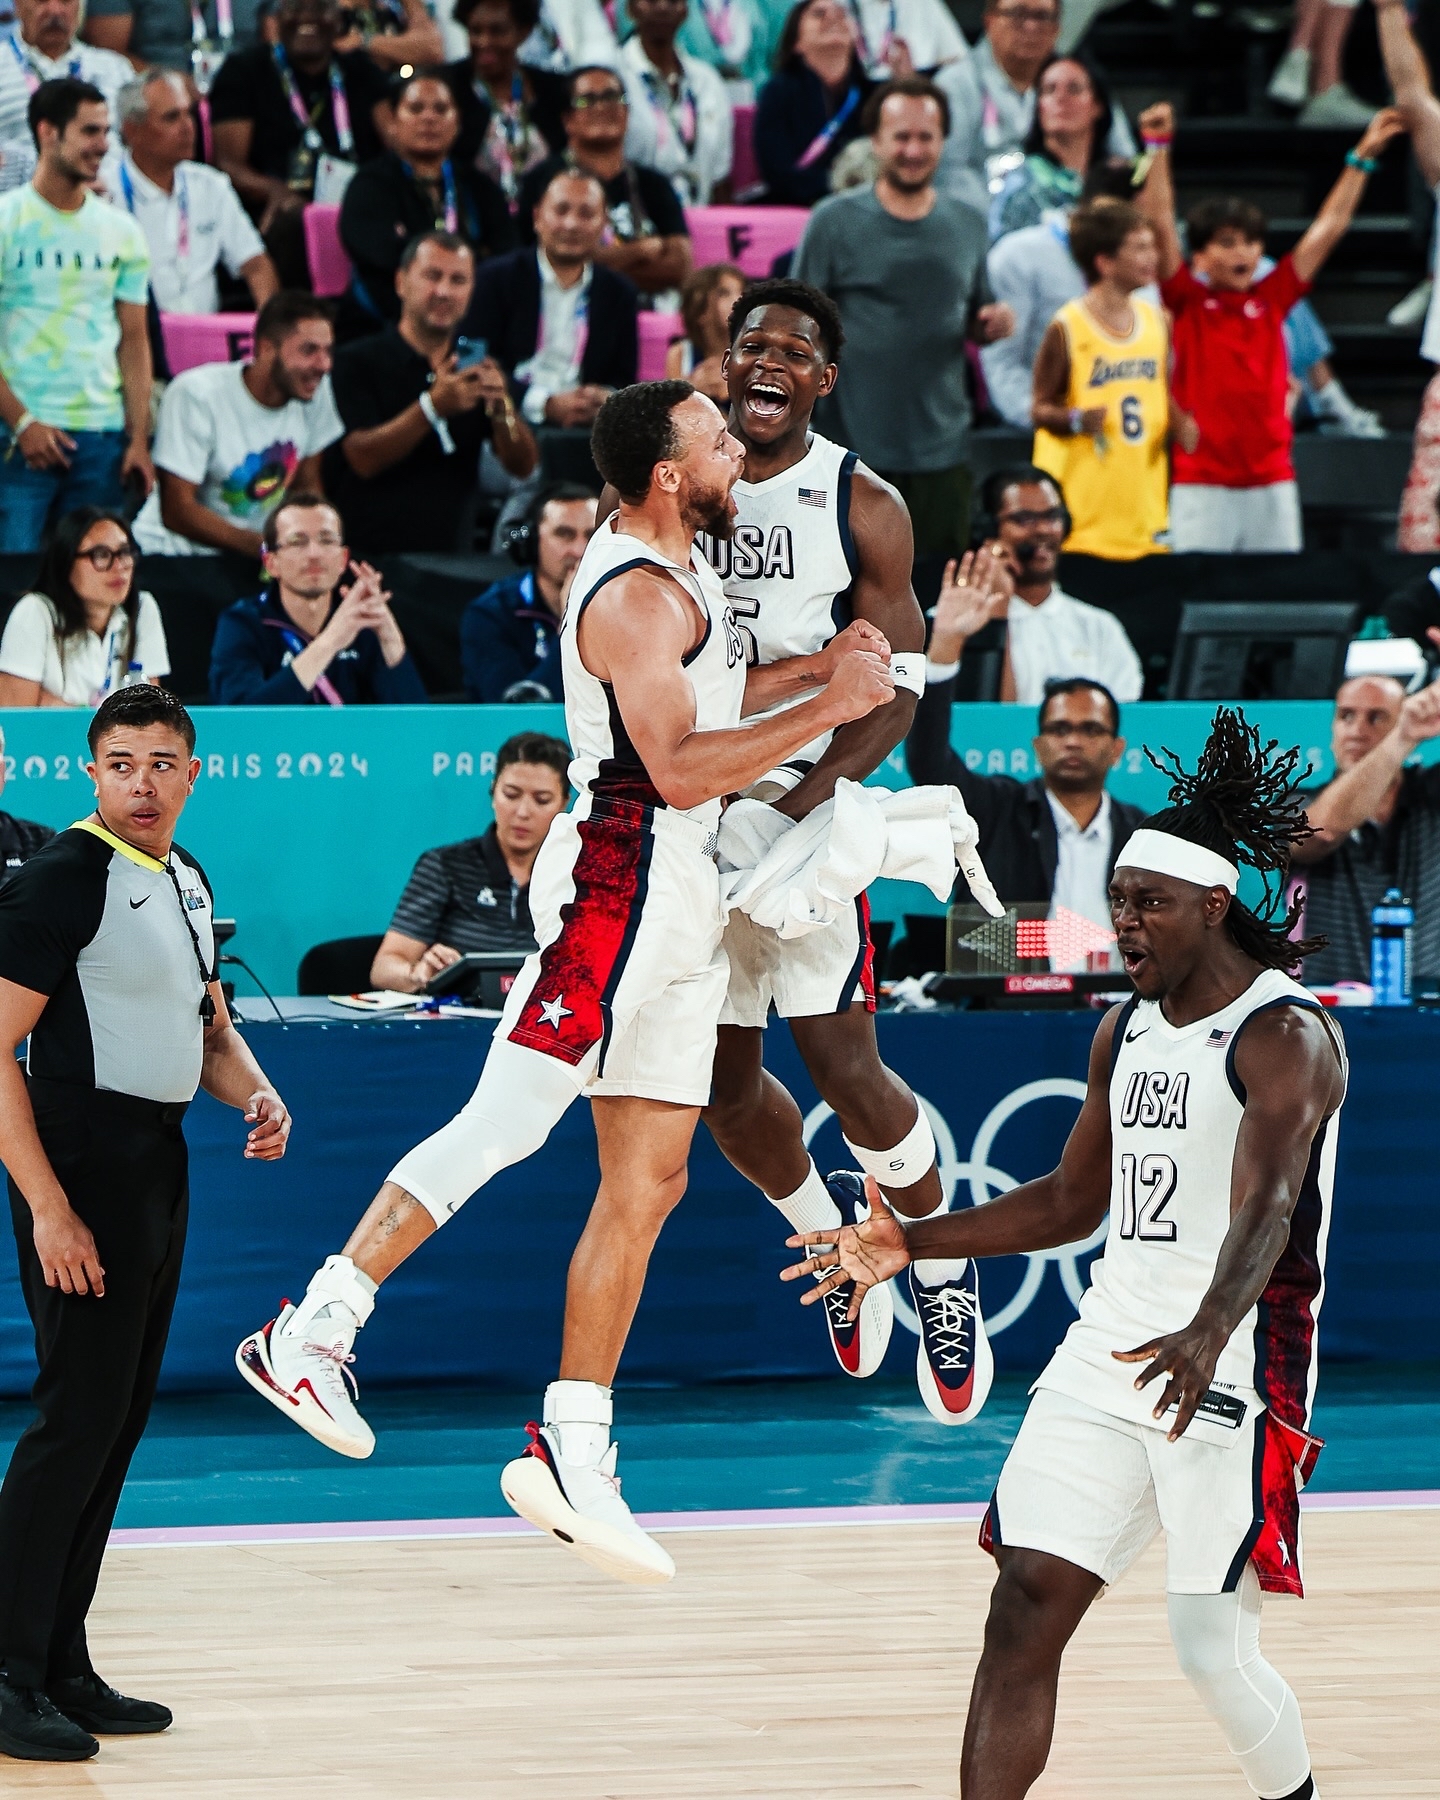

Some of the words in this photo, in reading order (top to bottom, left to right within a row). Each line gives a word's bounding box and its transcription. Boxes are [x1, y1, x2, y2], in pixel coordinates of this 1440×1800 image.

[727, 224, 752, 259] F
[1121, 396, 1143, 440] 6
[704, 525, 795, 580] USA
[207, 753, 262, 779] RIS
[275, 752, 369, 779] 2024
[432, 752, 497, 777] PAR
[965, 748, 1042, 774] PAR
[1120, 1071, 1190, 1130] USA
[1119, 1153, 1178, 1242] 12
